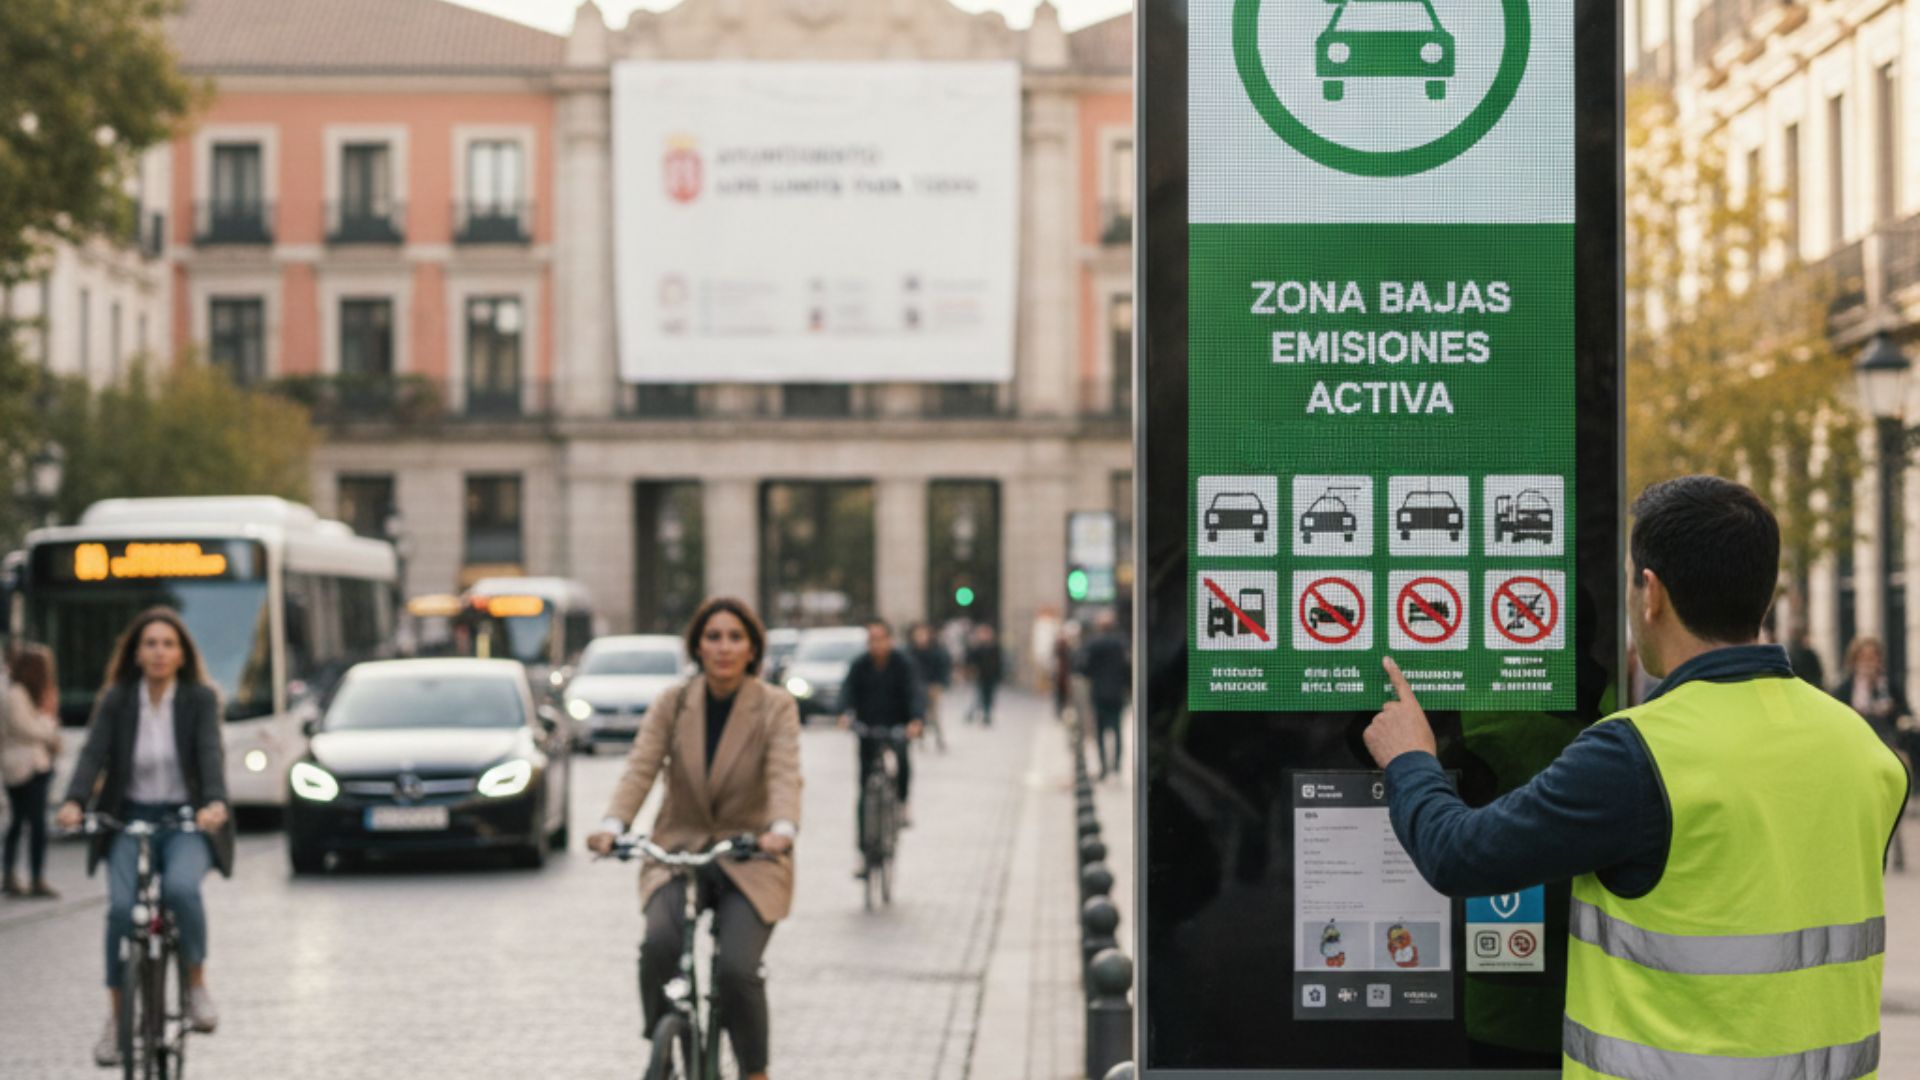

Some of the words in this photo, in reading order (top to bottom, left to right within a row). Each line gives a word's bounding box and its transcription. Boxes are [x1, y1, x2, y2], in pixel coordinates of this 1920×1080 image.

[1250, 280, 1367, 314] ZONA
[1379, 280, 1511, 314] BAJAS
[1271, 330, 1490, 364] EMISIONES
[1306, 380, 1454, 414] ACTIVA
